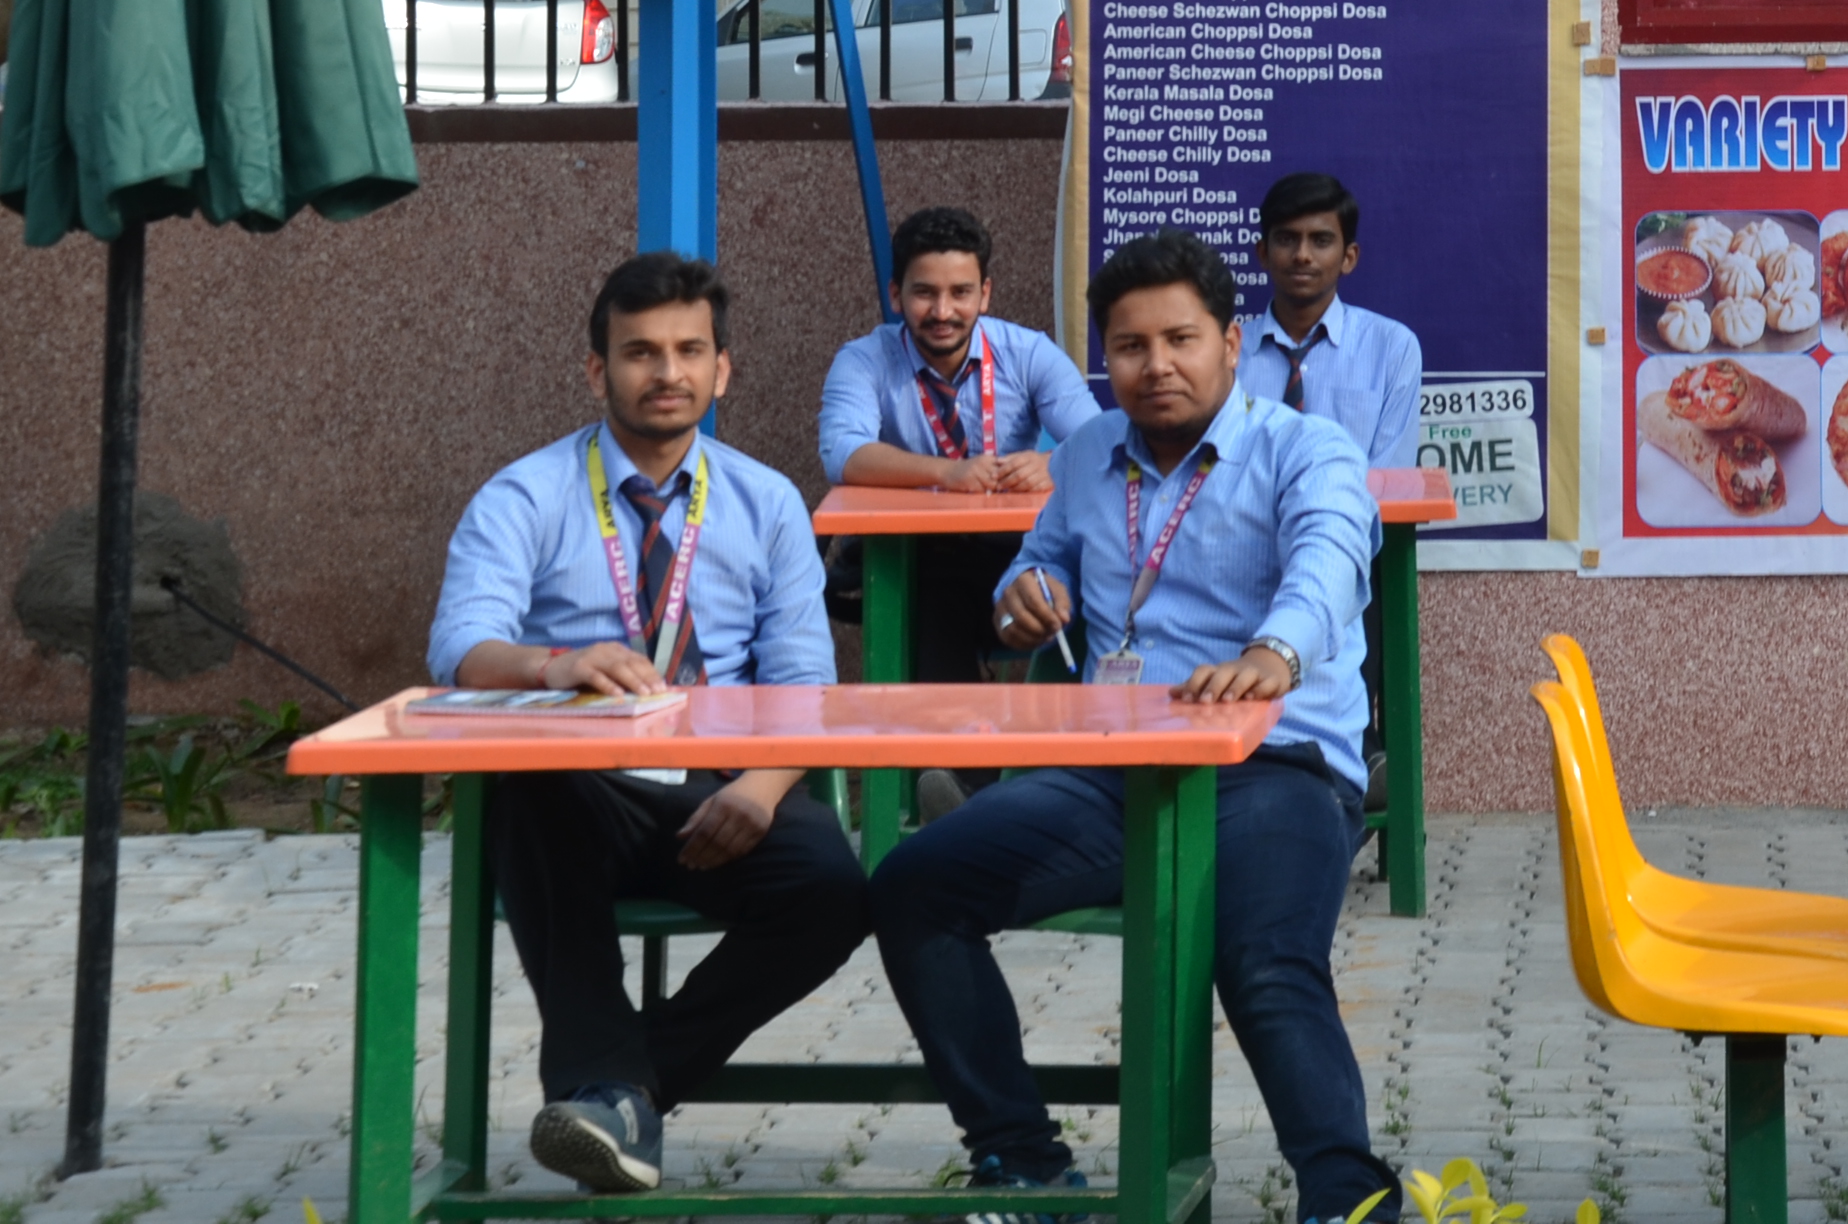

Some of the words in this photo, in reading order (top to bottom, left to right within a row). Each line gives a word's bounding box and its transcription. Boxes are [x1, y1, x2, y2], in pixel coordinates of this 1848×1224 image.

[1103, 23, 1186, 38] American
[1268, 24, 1313, 39] Dosa
[1103, 85, 1159, 100] Kerala
[1163, 85, 1225, 100] Masala
[1229, 84, 1274, 101] Dosa
[1103, 105, 1145, 124] Megi
[1149, 105, 1215, 120] Cheese
[1219, 105, 1264, 120] Dosa
[1635, 94, 1848, 174] VARIETY
[1103, 146, 1168, 162] Cheese
[1172, 146, 1223, 165] Chilly
[1226, 146, 1272, 162] Dosa
[1154, 167, 1199, 182] Dosa
[1192, 187, 1237, 203] Dosa
[1429, 424, 1472, 440] Free
[1416, 438, 1516, 475] OME
